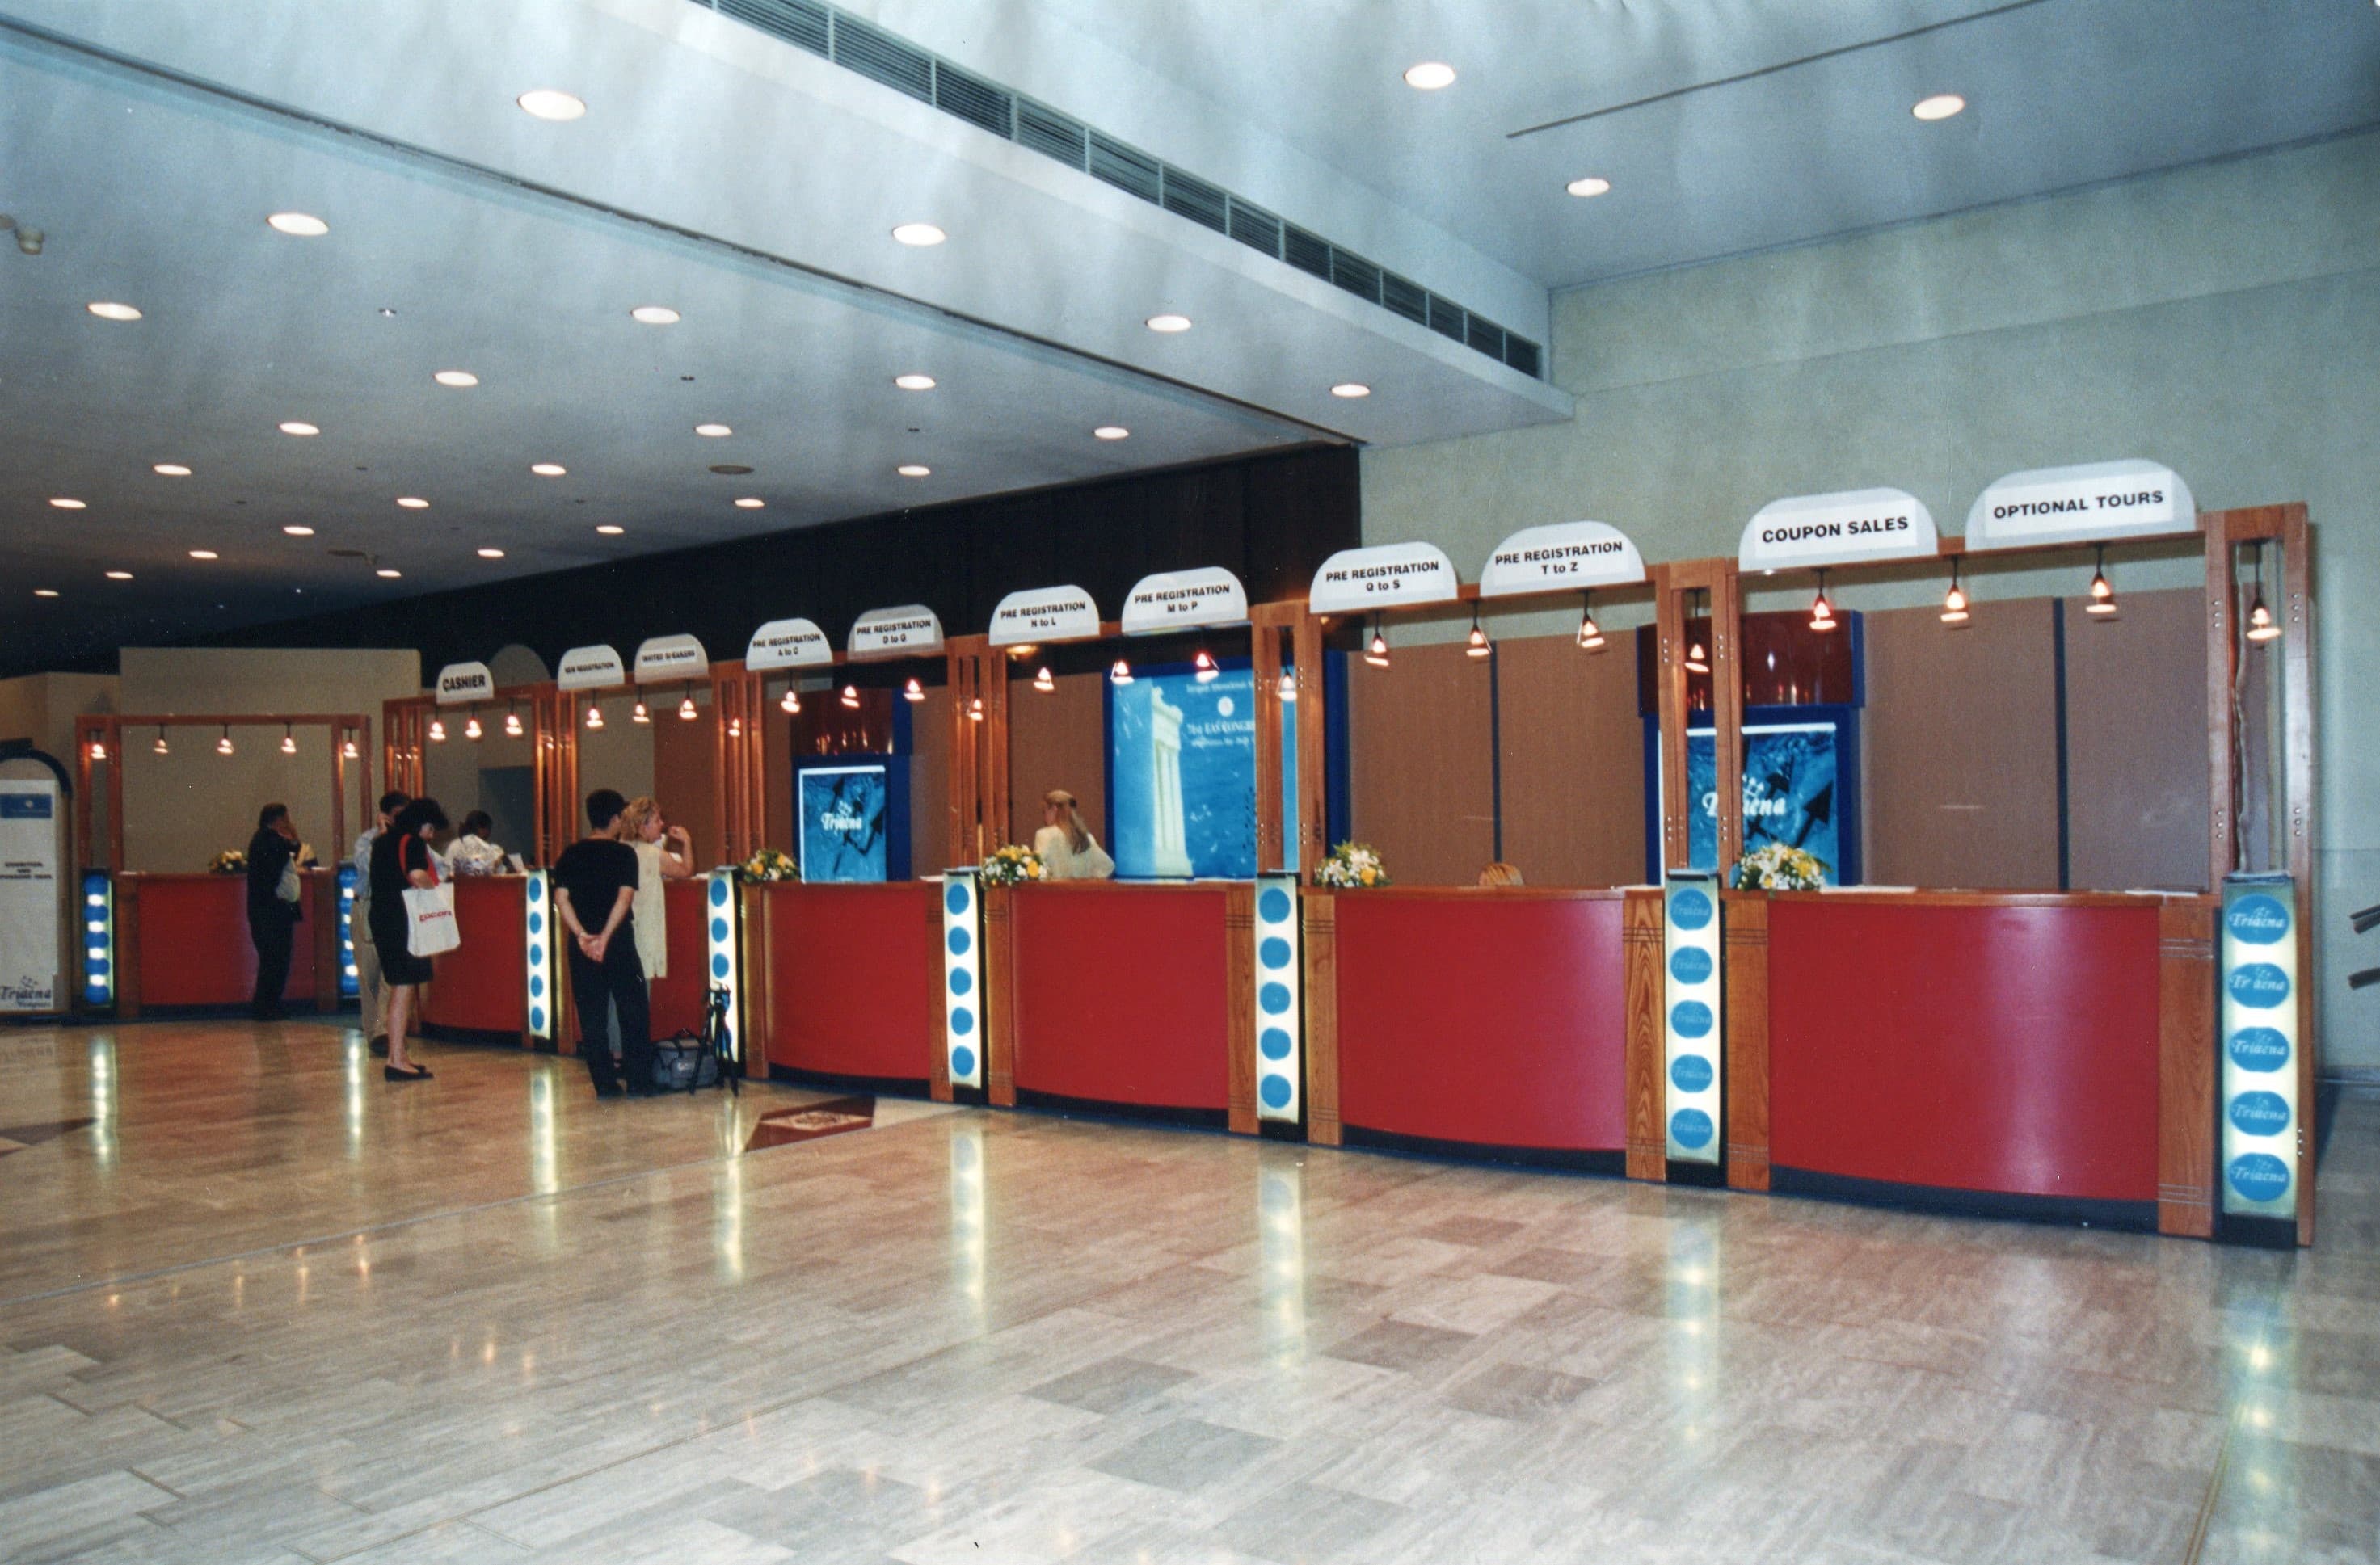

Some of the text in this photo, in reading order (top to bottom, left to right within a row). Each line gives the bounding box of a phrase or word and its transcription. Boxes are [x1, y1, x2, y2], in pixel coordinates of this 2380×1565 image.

[1993, 490, 2164, 520] OPTIONAL TOURS
[1762, 516, 1909, 544] COUPON SALES
[1494, 541, 1623, 565] PRE REGISTRATION
[1326, 562, 1439, 582] PRE REGISTRATION
[1541, 562, 1578, 574] T to Z
[1135, 584, 1230, 604] PRE REGISTRATION
[1366, 579, 1401, 592] Q to S
[1000, 601, 1085, 619] PRE REGISTRATION
[1167, 602, 1198, 613] M to P
[857, 619, 931, 635] PRE REGISTRATION
[1031, 618, 1056, 628] H to L
[752, 633, 820, 648] PRE REGISTRATION
[890, 635, 899, 643] to
[442, 674, 486, 692] CASHIER
